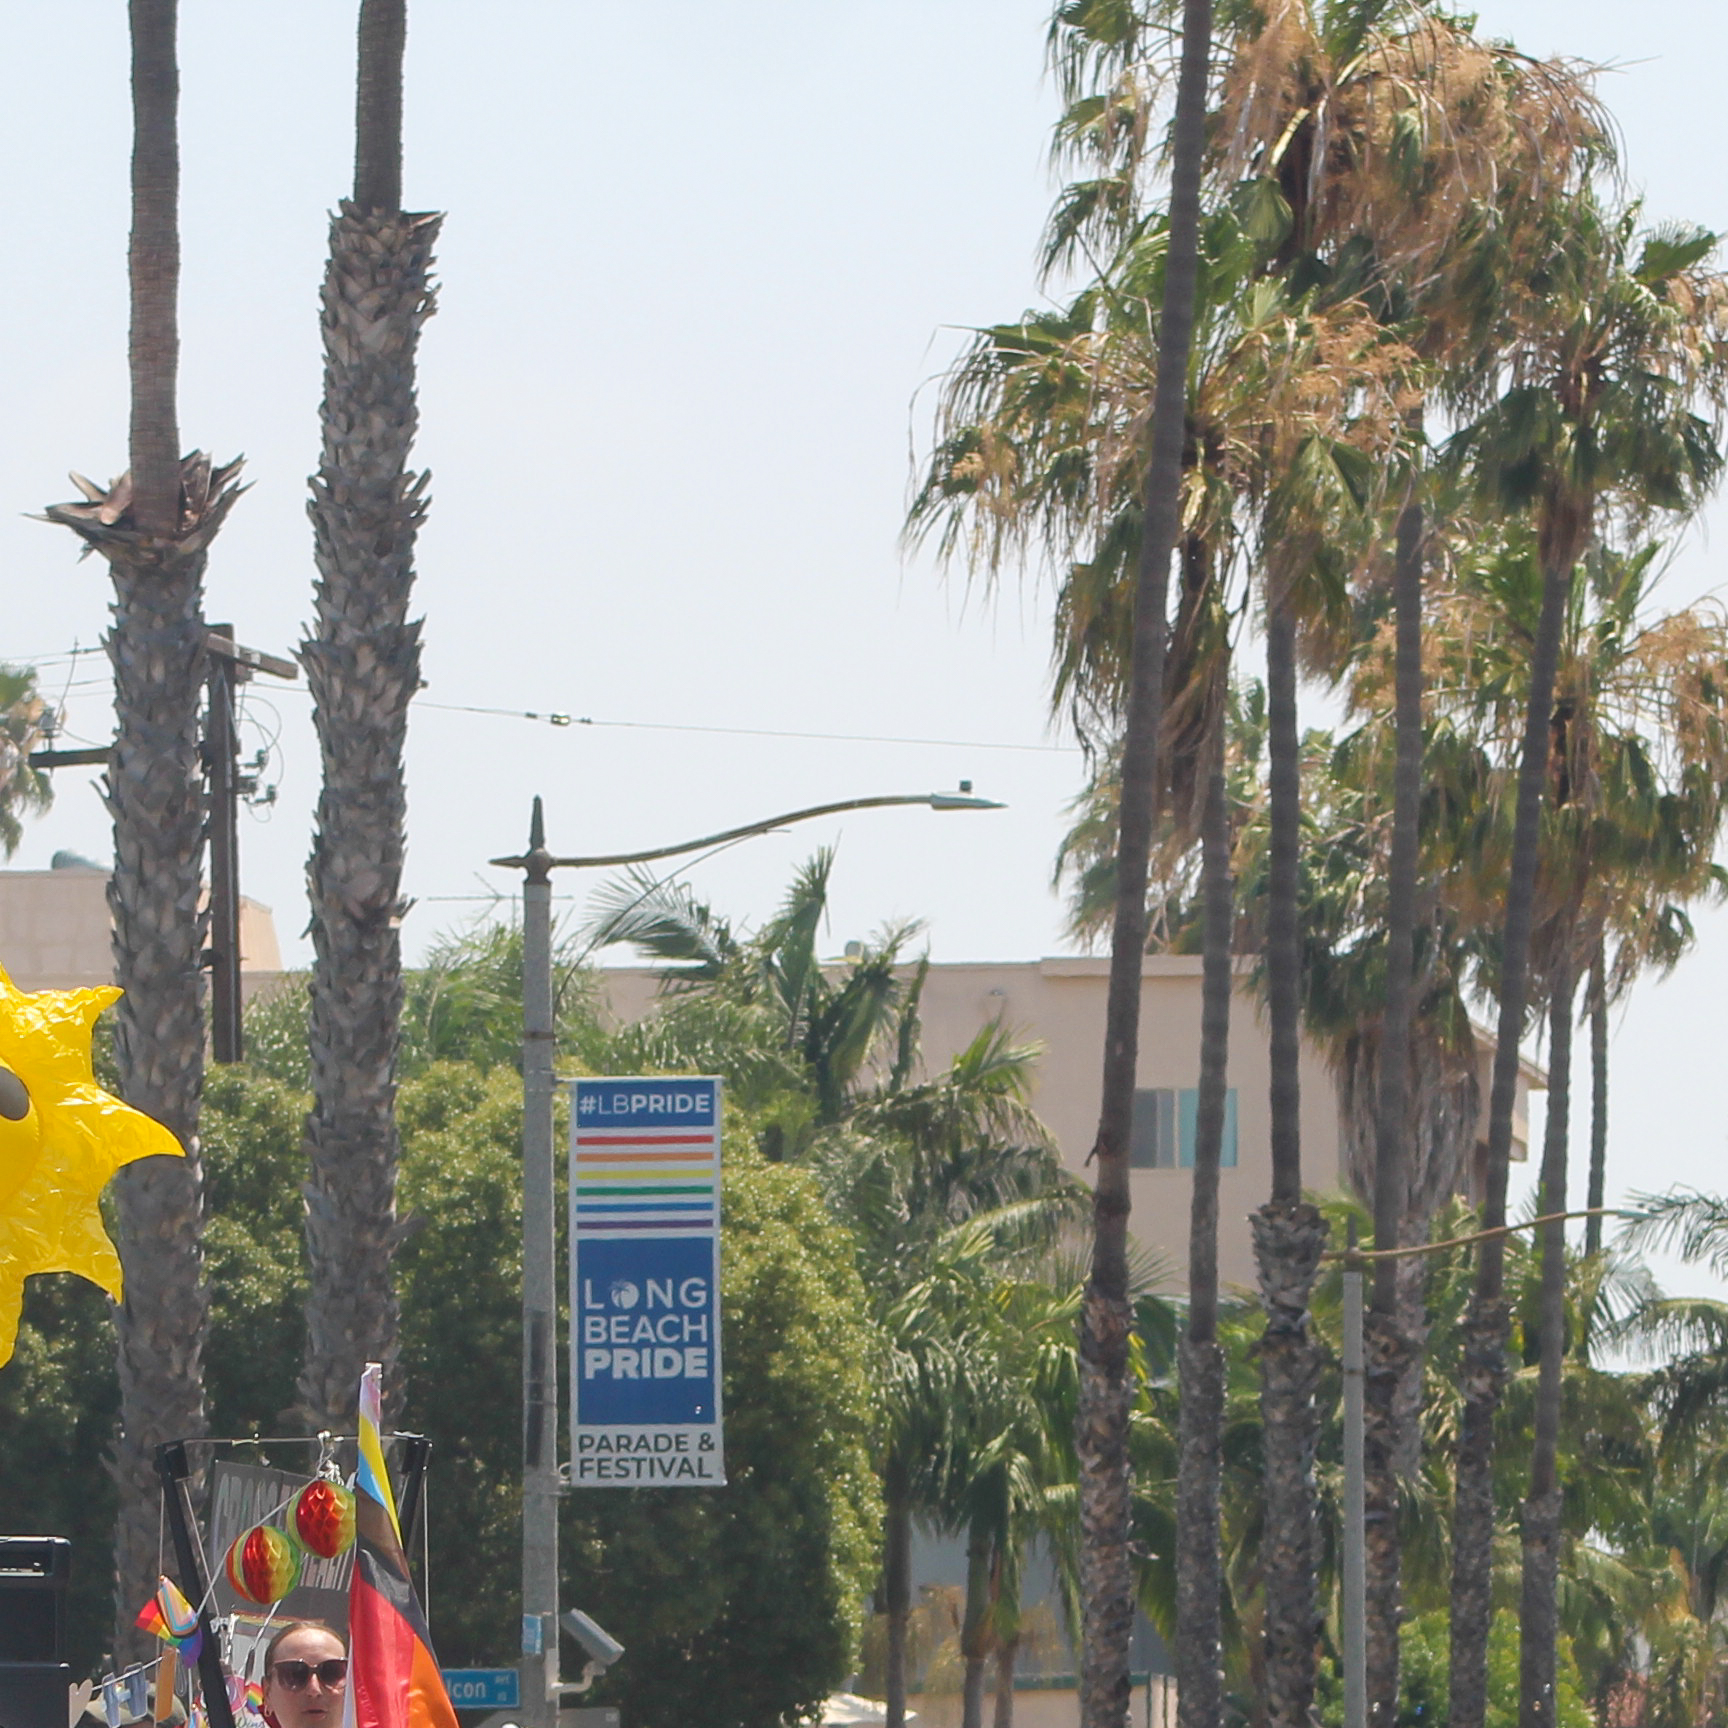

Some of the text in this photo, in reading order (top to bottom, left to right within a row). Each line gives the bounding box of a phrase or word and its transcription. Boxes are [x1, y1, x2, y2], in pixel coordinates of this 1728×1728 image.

[579, 1093, 711, 1115] #LBPRIDE
[585, 1277, 707, 1310] LONG
[585, 1314, 708, 1344] BEACH
[585, 1347, 708, 1380] PRIDE
[579, 1433, 715, 1454] PARADE &
[579, 1456, 713, 1479] FESTIVAL
